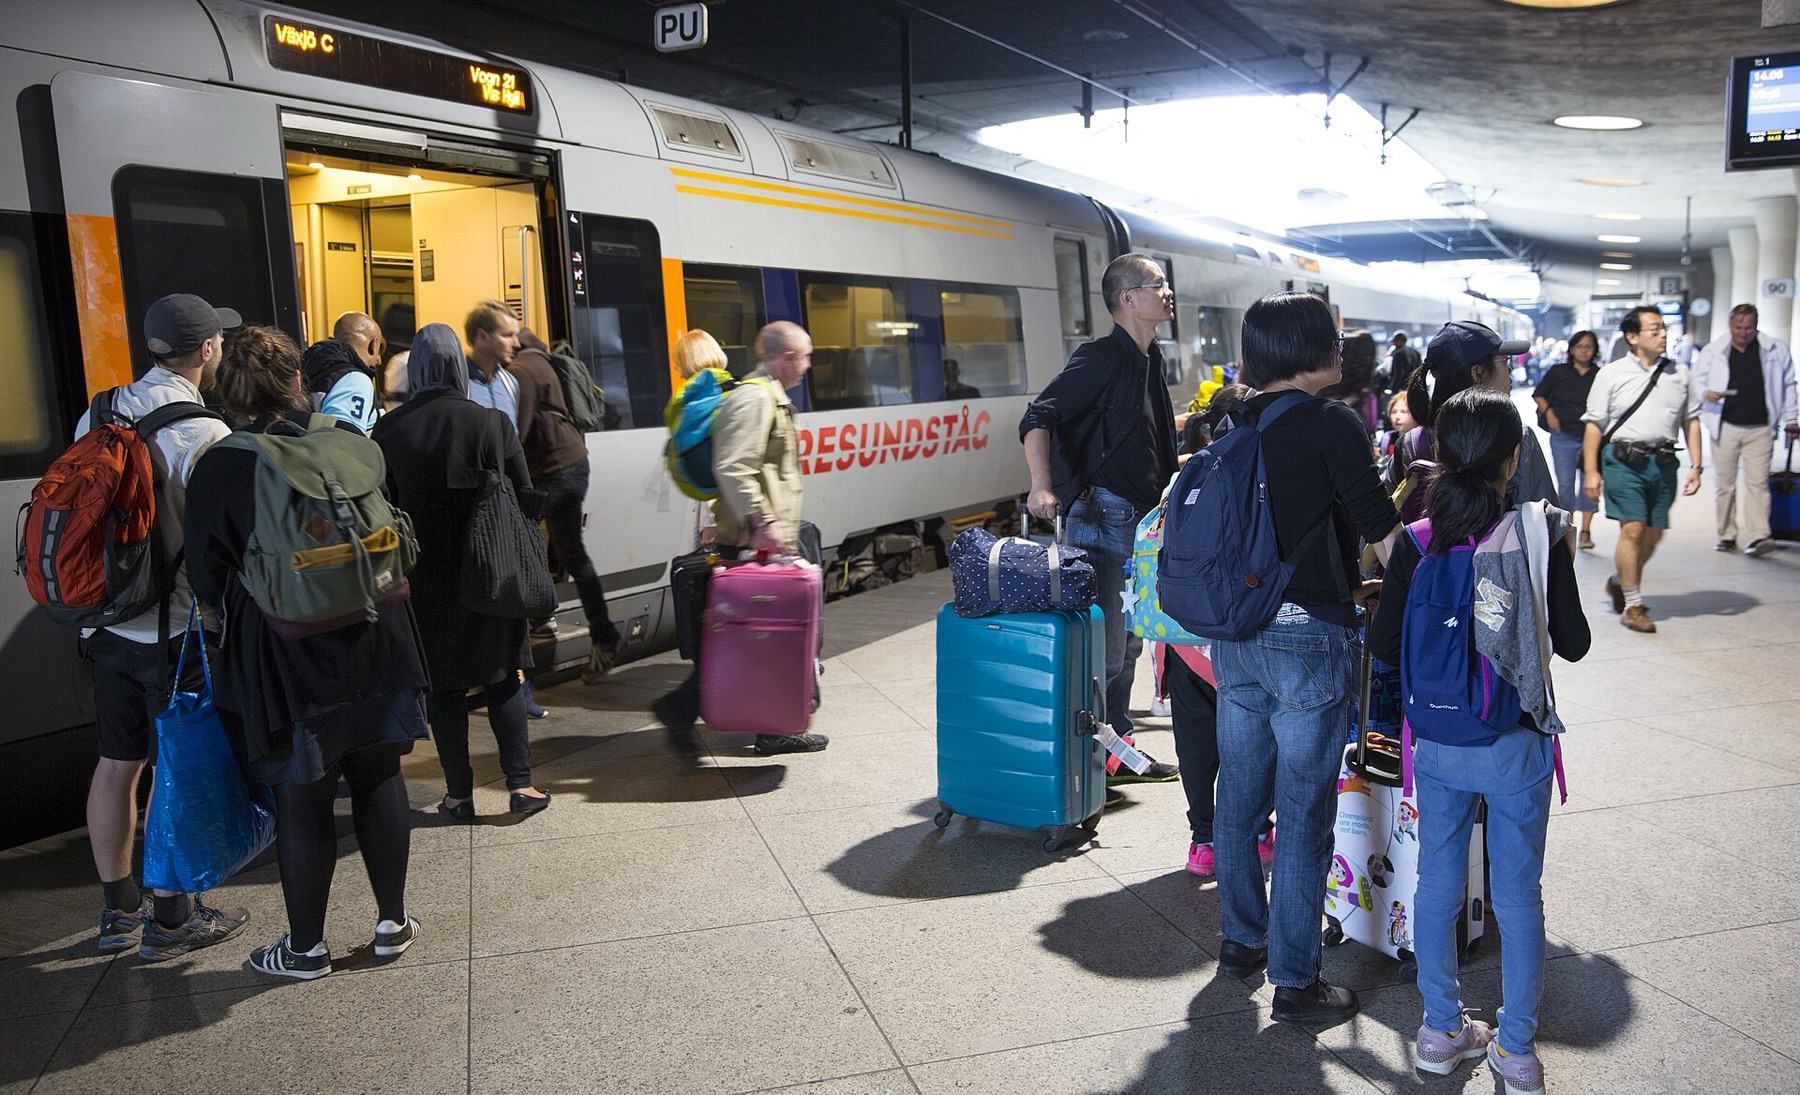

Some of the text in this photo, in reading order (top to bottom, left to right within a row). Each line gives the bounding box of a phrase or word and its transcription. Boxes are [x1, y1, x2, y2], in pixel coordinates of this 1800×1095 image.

[275, 22, 334, 53] Växjö C
[661, 11, 698, 44] PU
[470, 65, 500, 87] Vogn
[351, 395, 365, 420] 3
[796, 404, 991, 476] RESUNDSTÅG
[1339, 811, 1373, 822] Champions
